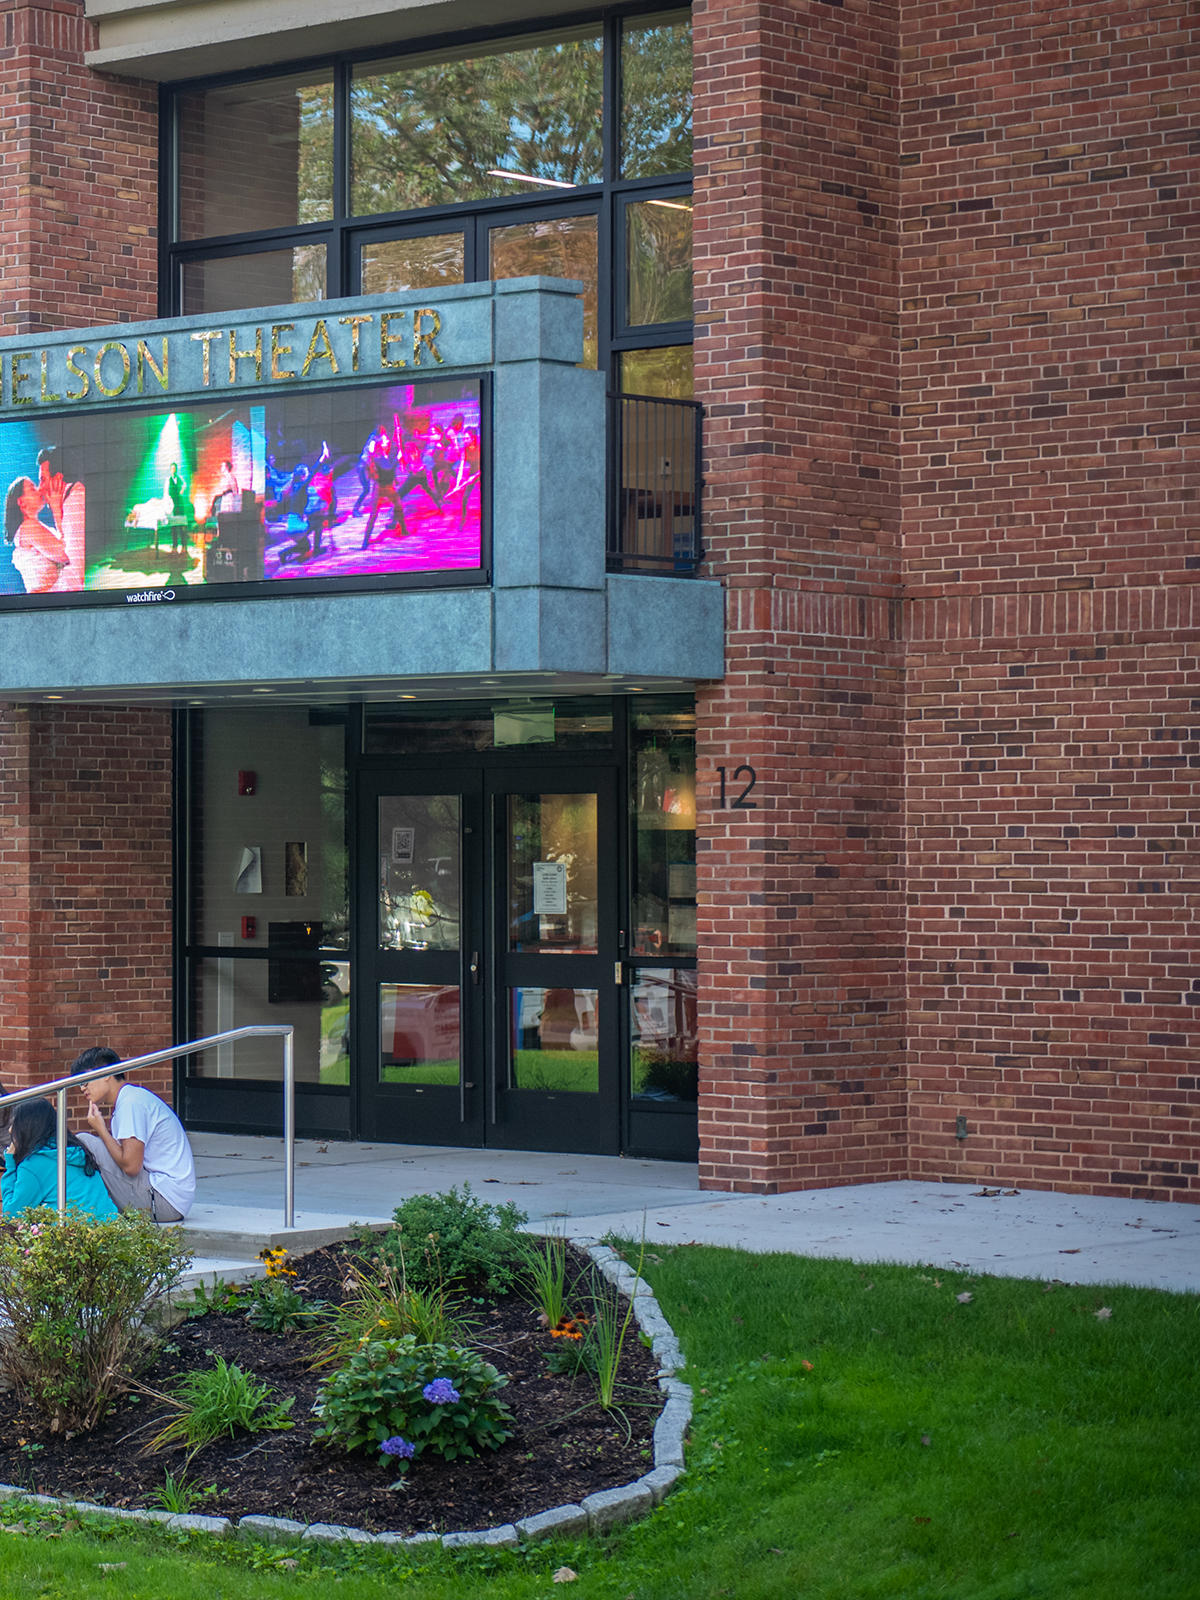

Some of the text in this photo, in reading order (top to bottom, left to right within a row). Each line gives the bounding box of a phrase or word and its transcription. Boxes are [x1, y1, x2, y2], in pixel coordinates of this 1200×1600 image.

[190, 309, 444, 386] THEATER
[126, 590, 162, 603] watchfire
[716, 765, 757, 808] 12
